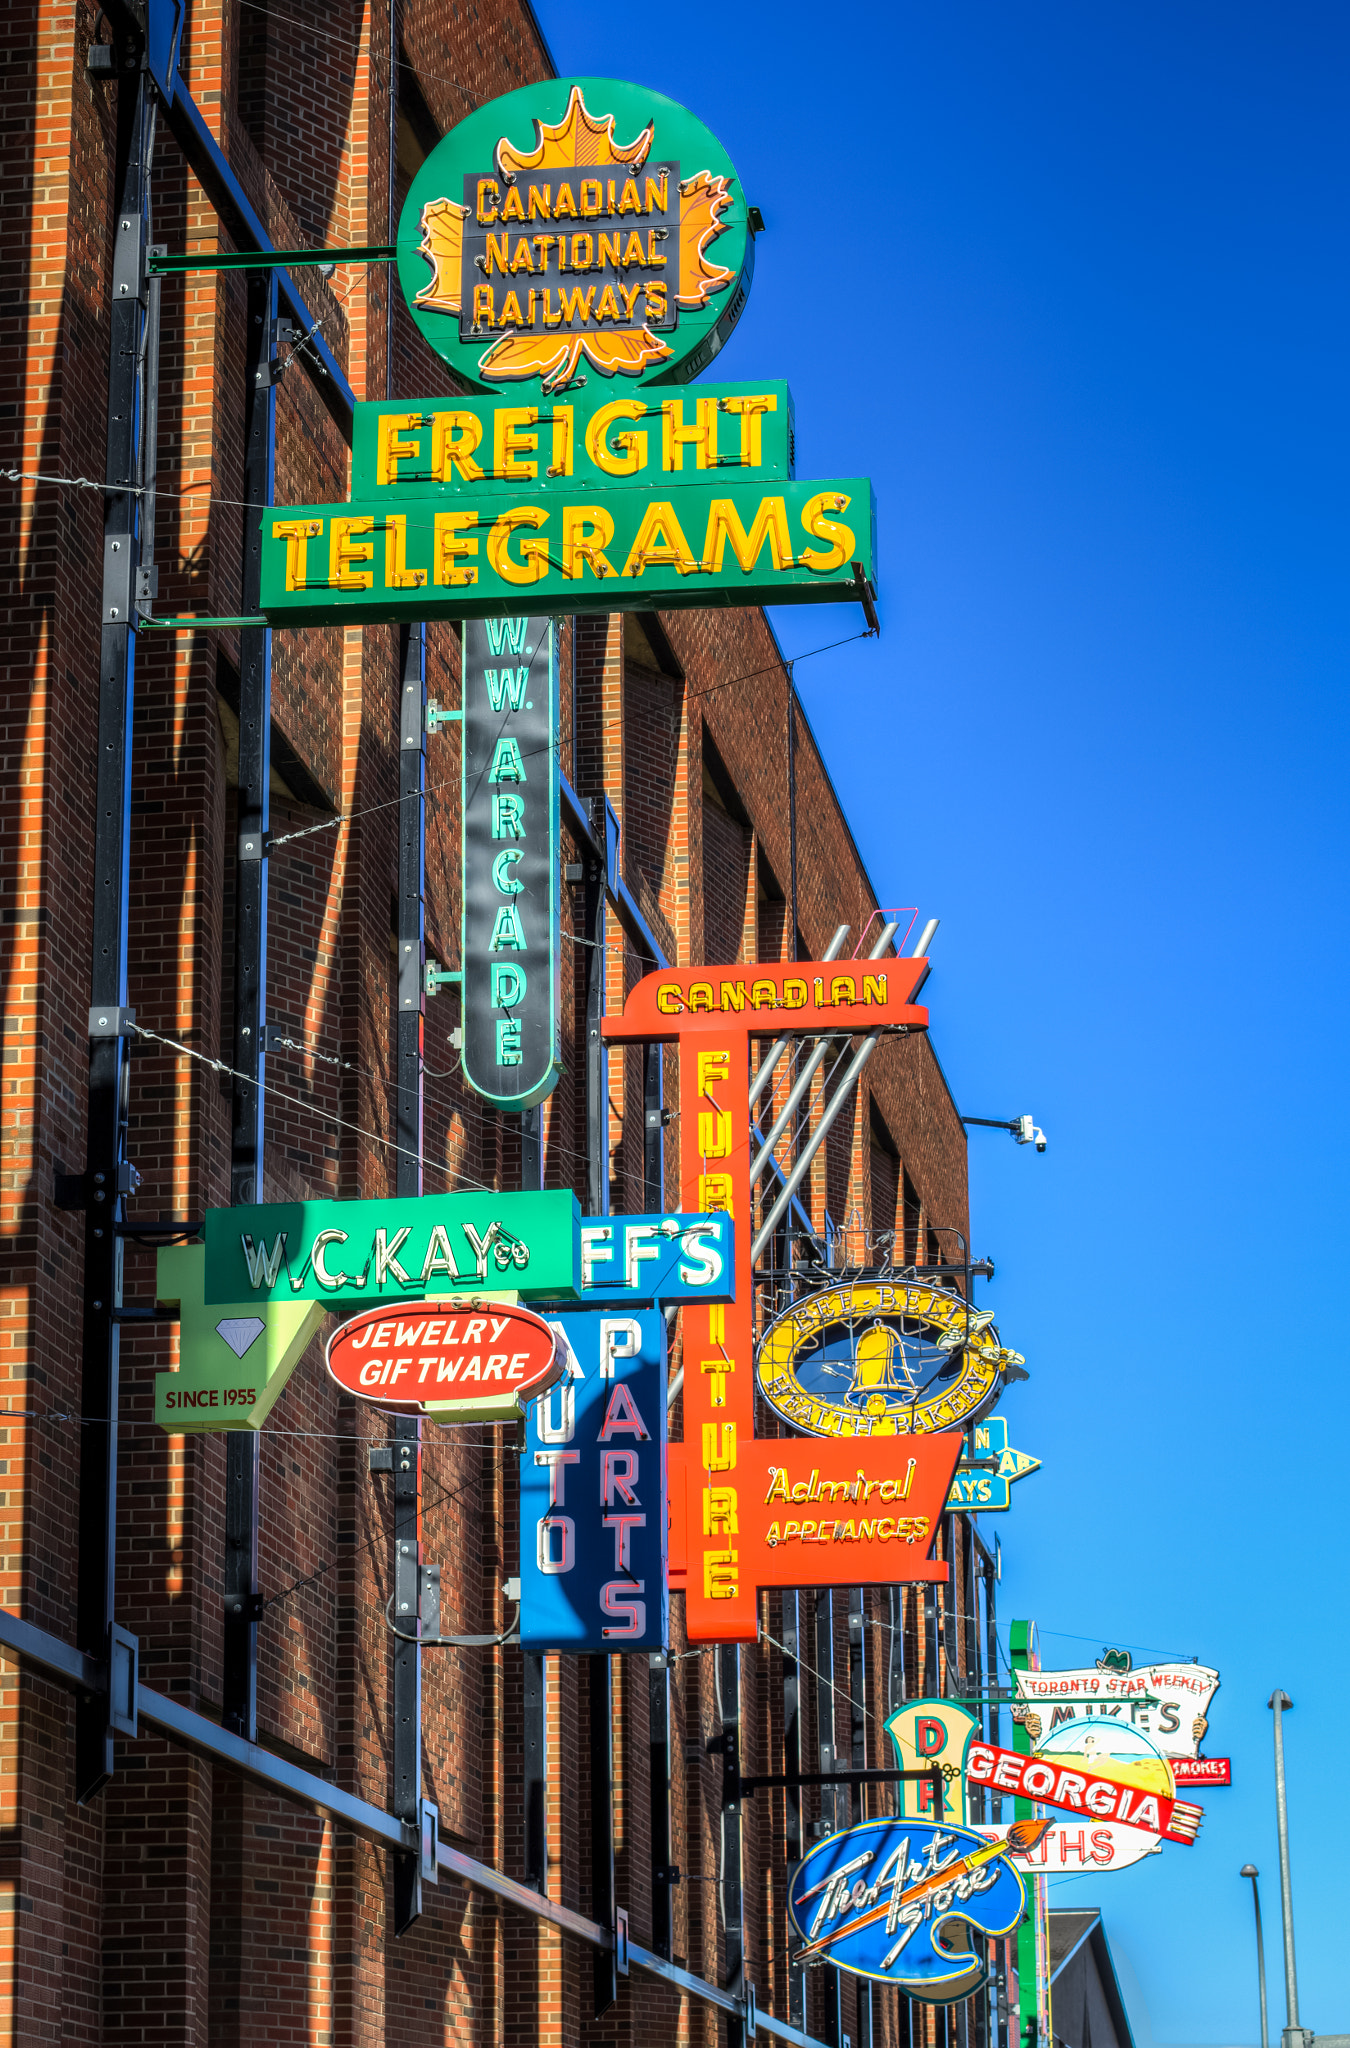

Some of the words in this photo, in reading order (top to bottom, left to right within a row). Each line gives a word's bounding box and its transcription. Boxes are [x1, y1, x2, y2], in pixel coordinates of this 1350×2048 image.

[476, 176, 668, 223] CANADIAN
[485, 230, 668, 273] NATIONAL
[473, 281, 668, 327] RAILWAYS
[376, 394, 778, 485] FREIGHT
[272, 491, 857, 592] TELEGRAMS
[487, 738, 528, 1067] ARCADE
[656, 975, 888, 1014] CANADIAN
[352, 1318, 511, 1349] JEWELRY
[697, 1051, 739, 1599] FURITURE
[165, 1390, 219, 1409] SINCE
[223, 1388, 257, 1406] 1955
[764, 1372, 878, 1437] HEALTH
[891, 1365, 988, 1436] BAKERY
[596, 1318, 652, 1640] PARTS
[764, 1461, 917, 1504] Admiral
[764, 1516, 931, 1542] APPLIANCES
[1029, 1678, 1100, 1694] TORONTO
[1109, 1678, 1146, 1694] STAR
[1151, 1674, 1211, 1694] WEEKLY
[966, 1746, 1161, 1833] GEORGIA
[1173, 1761, 1226, 1776] SMOKES
[795, 1849, 874, 1938] The
[873, 1829, 960, 1935] Art
[879, 1867, 1001, 1969] Store
